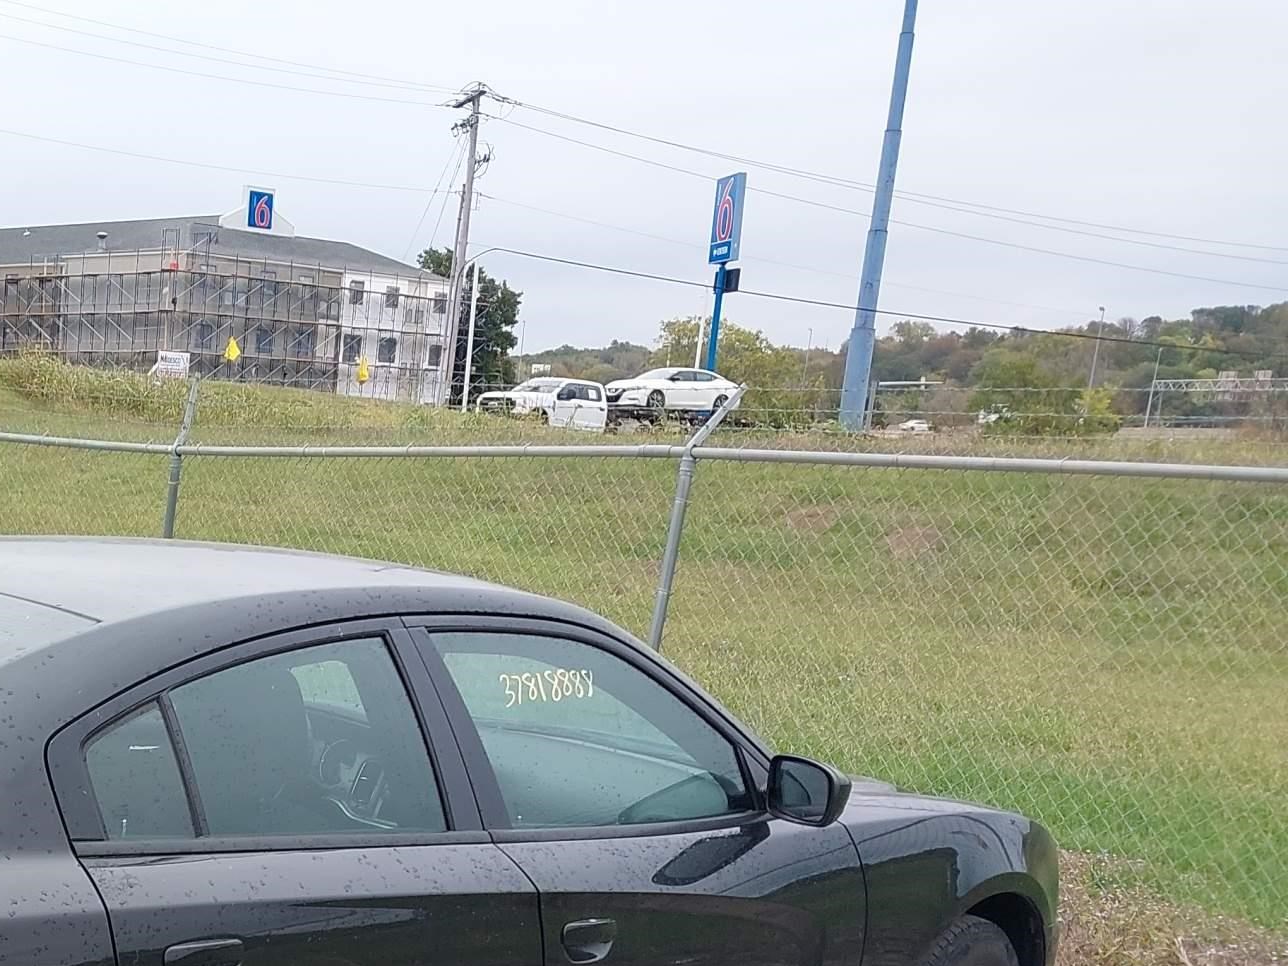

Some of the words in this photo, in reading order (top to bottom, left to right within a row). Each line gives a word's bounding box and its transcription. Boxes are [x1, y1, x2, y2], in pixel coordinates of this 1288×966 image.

[255, 195, 271, 227] 6
[717, 177, 734, 241] 6
[499, 668, 594, 708] 37818888
